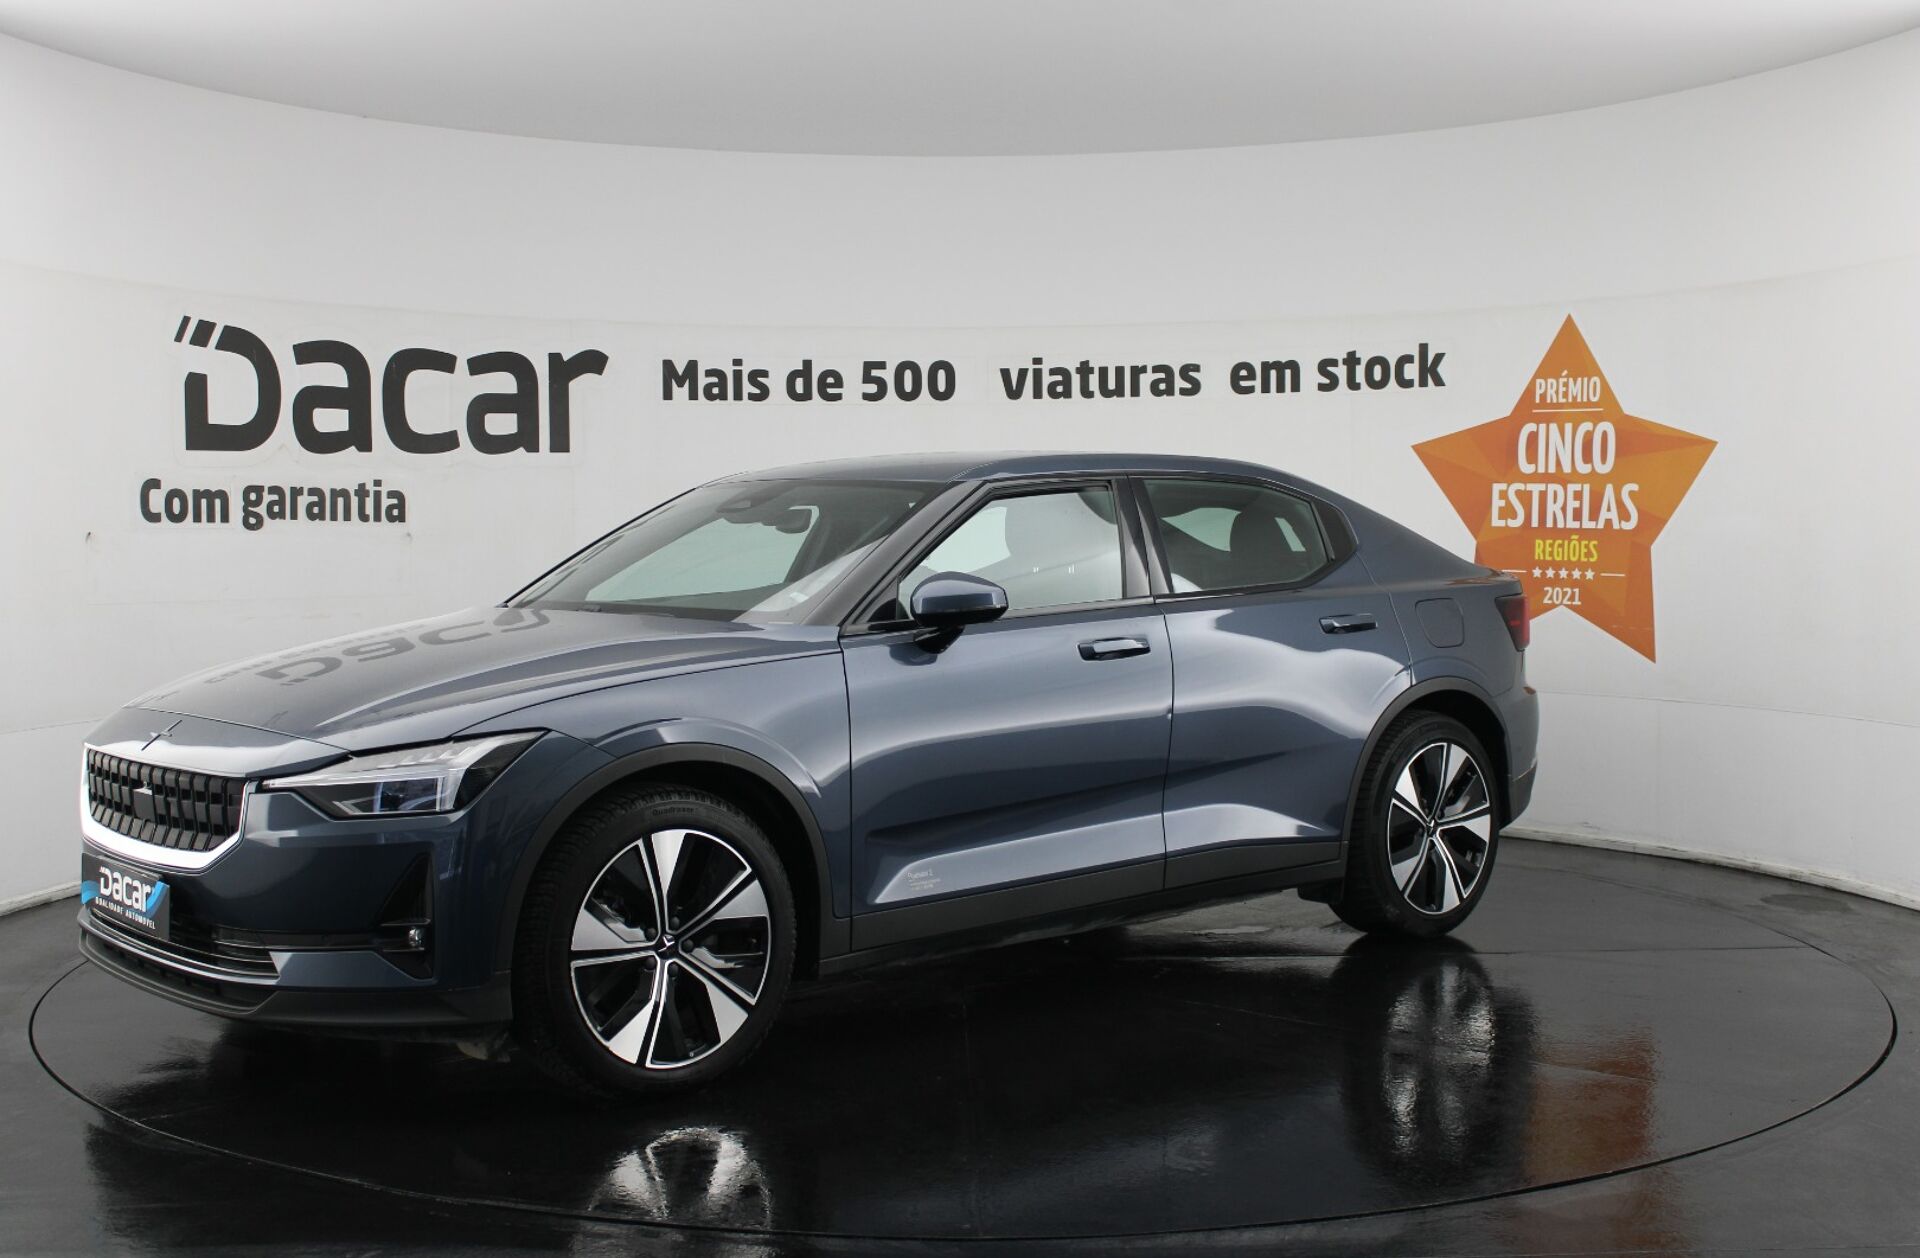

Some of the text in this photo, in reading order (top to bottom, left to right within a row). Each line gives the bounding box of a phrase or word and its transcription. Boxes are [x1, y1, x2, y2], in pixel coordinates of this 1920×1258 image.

[174, 315, 609, 455] Dacar
[662, 342, 1447, 402] Mais de 500 viaturas em stock
[1535, 370, 1601, 404] PRÉMIO
[1517, 421, 1616, 475] CINCO
[140, 478, 407, 531] Com garantia
[1491, 483, 1639, 530] ESTRELAS
[1534, 535, 1599, 562] REGIÕES
[1543, 586, 1582, 606] 2021
[99, 866, 152, 913] Dacar
